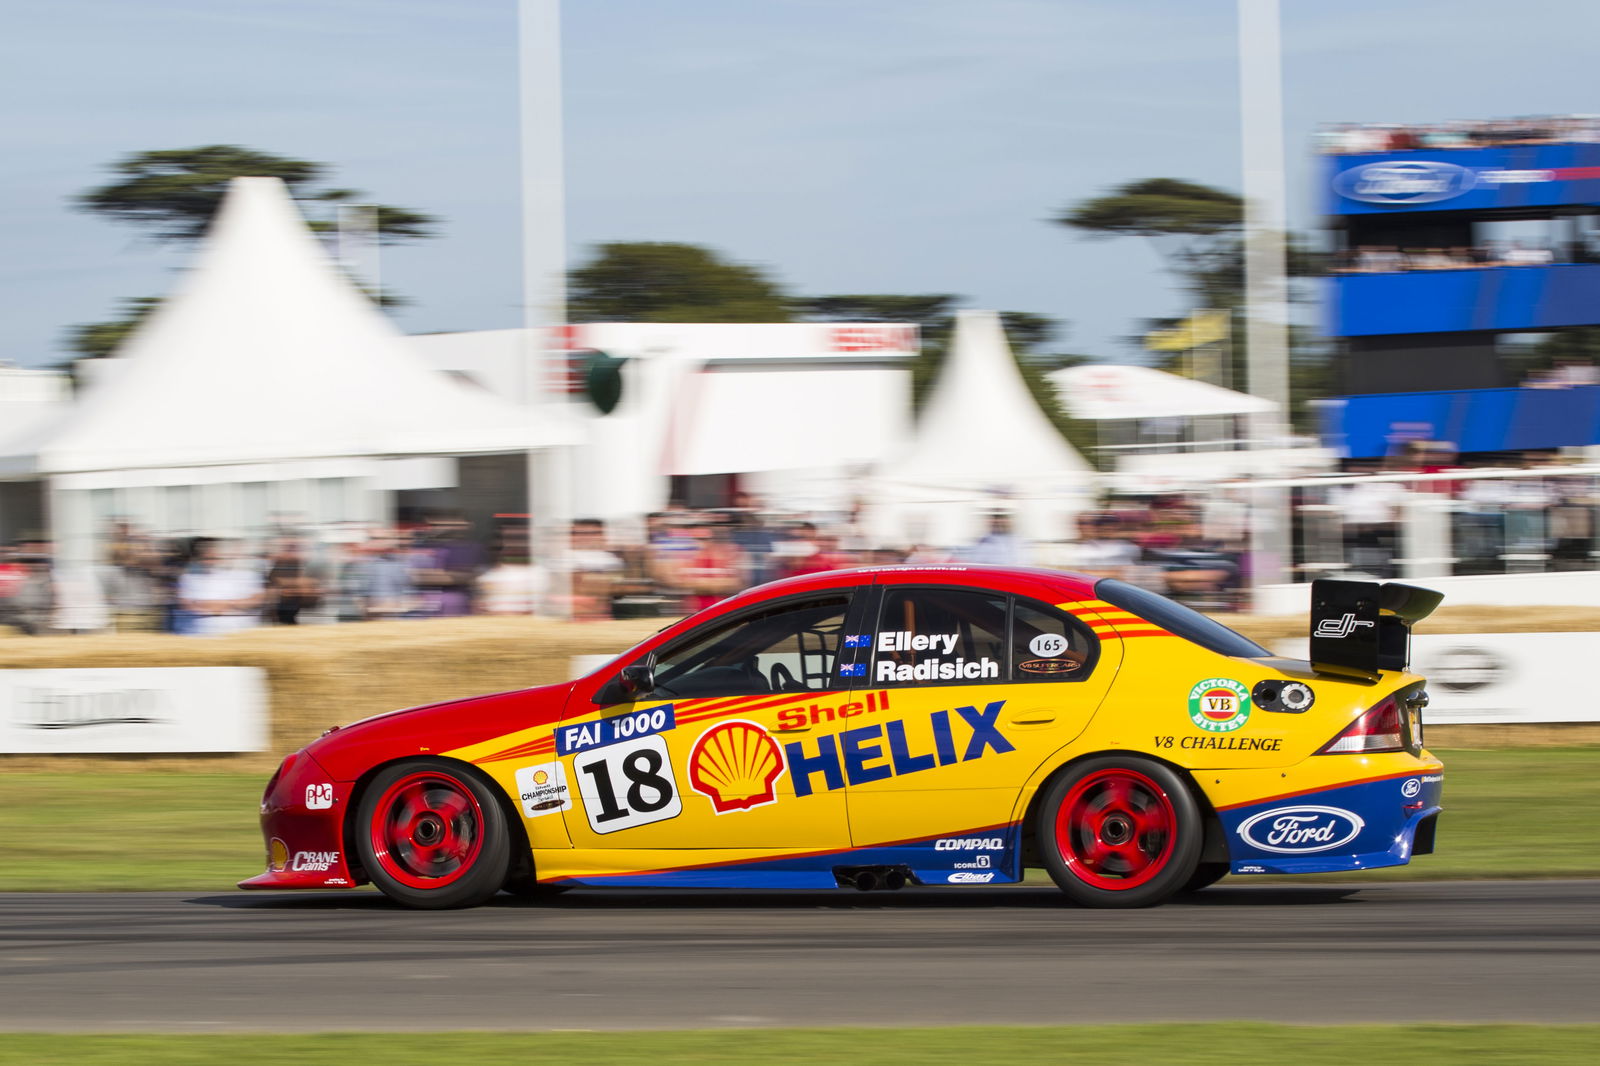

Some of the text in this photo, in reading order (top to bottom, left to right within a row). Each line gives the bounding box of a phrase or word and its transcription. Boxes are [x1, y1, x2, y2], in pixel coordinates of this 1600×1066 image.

[878, 631, 959, 655] Ellery
[1037, 639, 1060, 651] 165
[877, 657, 999, 681] Radisich
[1190, 679, 1249, 702] VICTORIA
[777, 690, 889, 730] Shell
[1208, 698, 1231, 710] VB
[565, 709, 666, 751] FAI 1000
[1192, 713, 1247, 732] BITTER
[785, 700, 1016, 798] HELIX
[1154, 736, 1283, 751] V8 CHALLENGE
[307, 784, 331, 804] PPG
[521, 785, 567, 801] CHAMPIONSHIP
[582, 748, 673, 824] 18
[1267, 815, 1336, 845] Ford
[934, 838, 1004, 850] COMPAQ
[292, 851, 340, 867] CRANE
